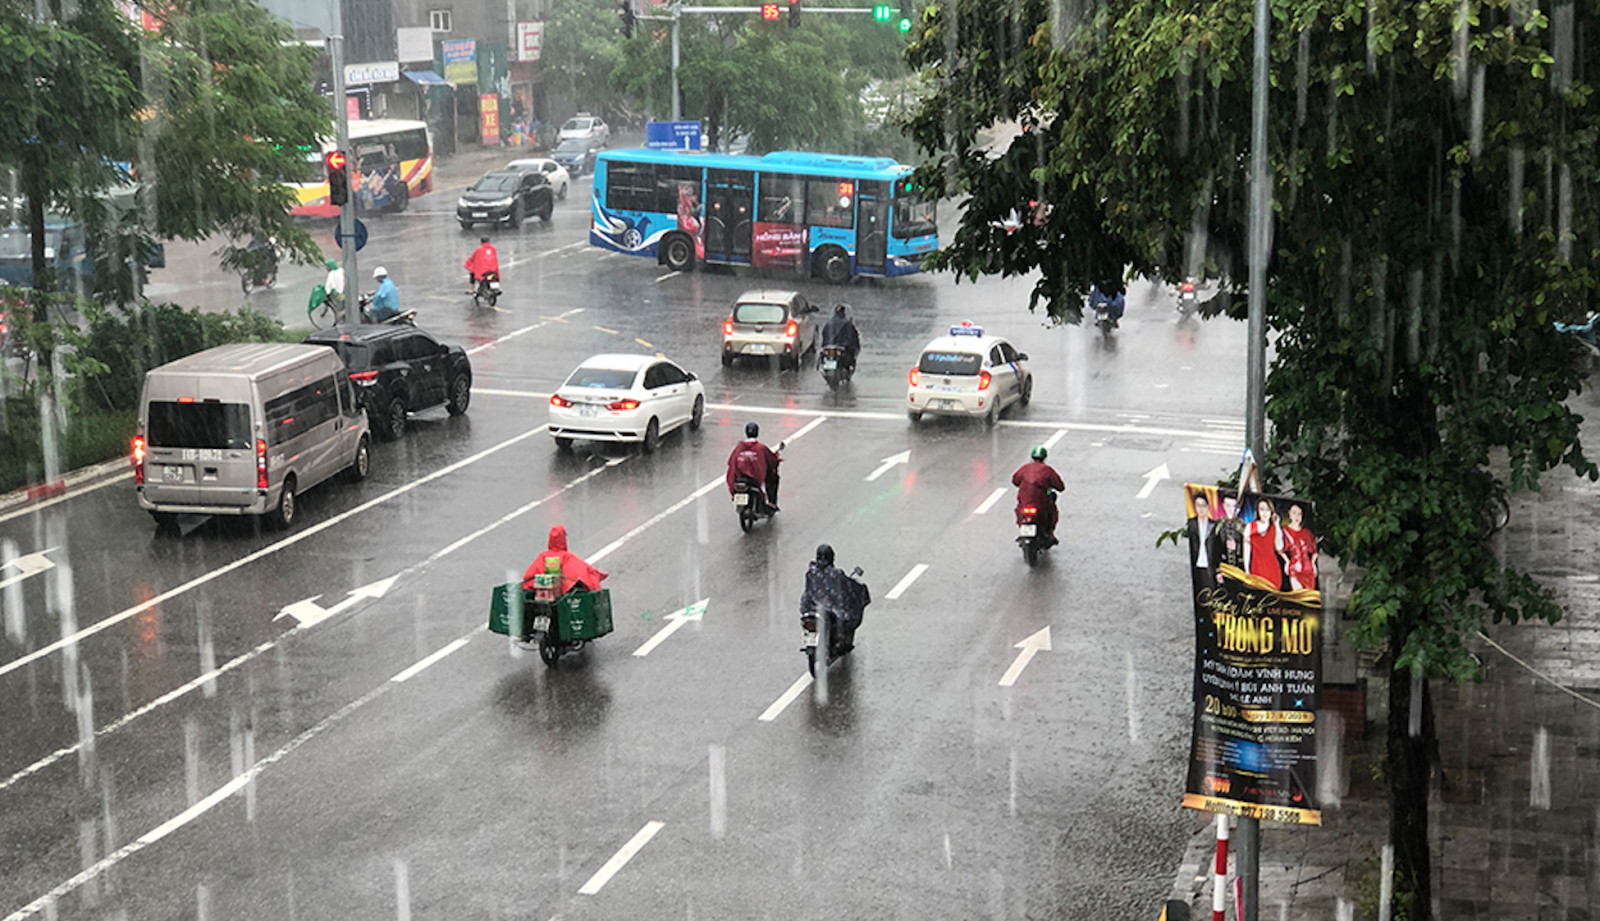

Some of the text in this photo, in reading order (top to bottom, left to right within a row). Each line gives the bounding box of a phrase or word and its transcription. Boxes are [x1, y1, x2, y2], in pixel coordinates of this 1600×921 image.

[763, 4, 779, 19] 35
[839, 182, 854, 195] 31
[1212, 612, 1274, 654] TRONG
[1260, 682, 1283, 694] ANH
[1205, 694, 1220, 715] 20
